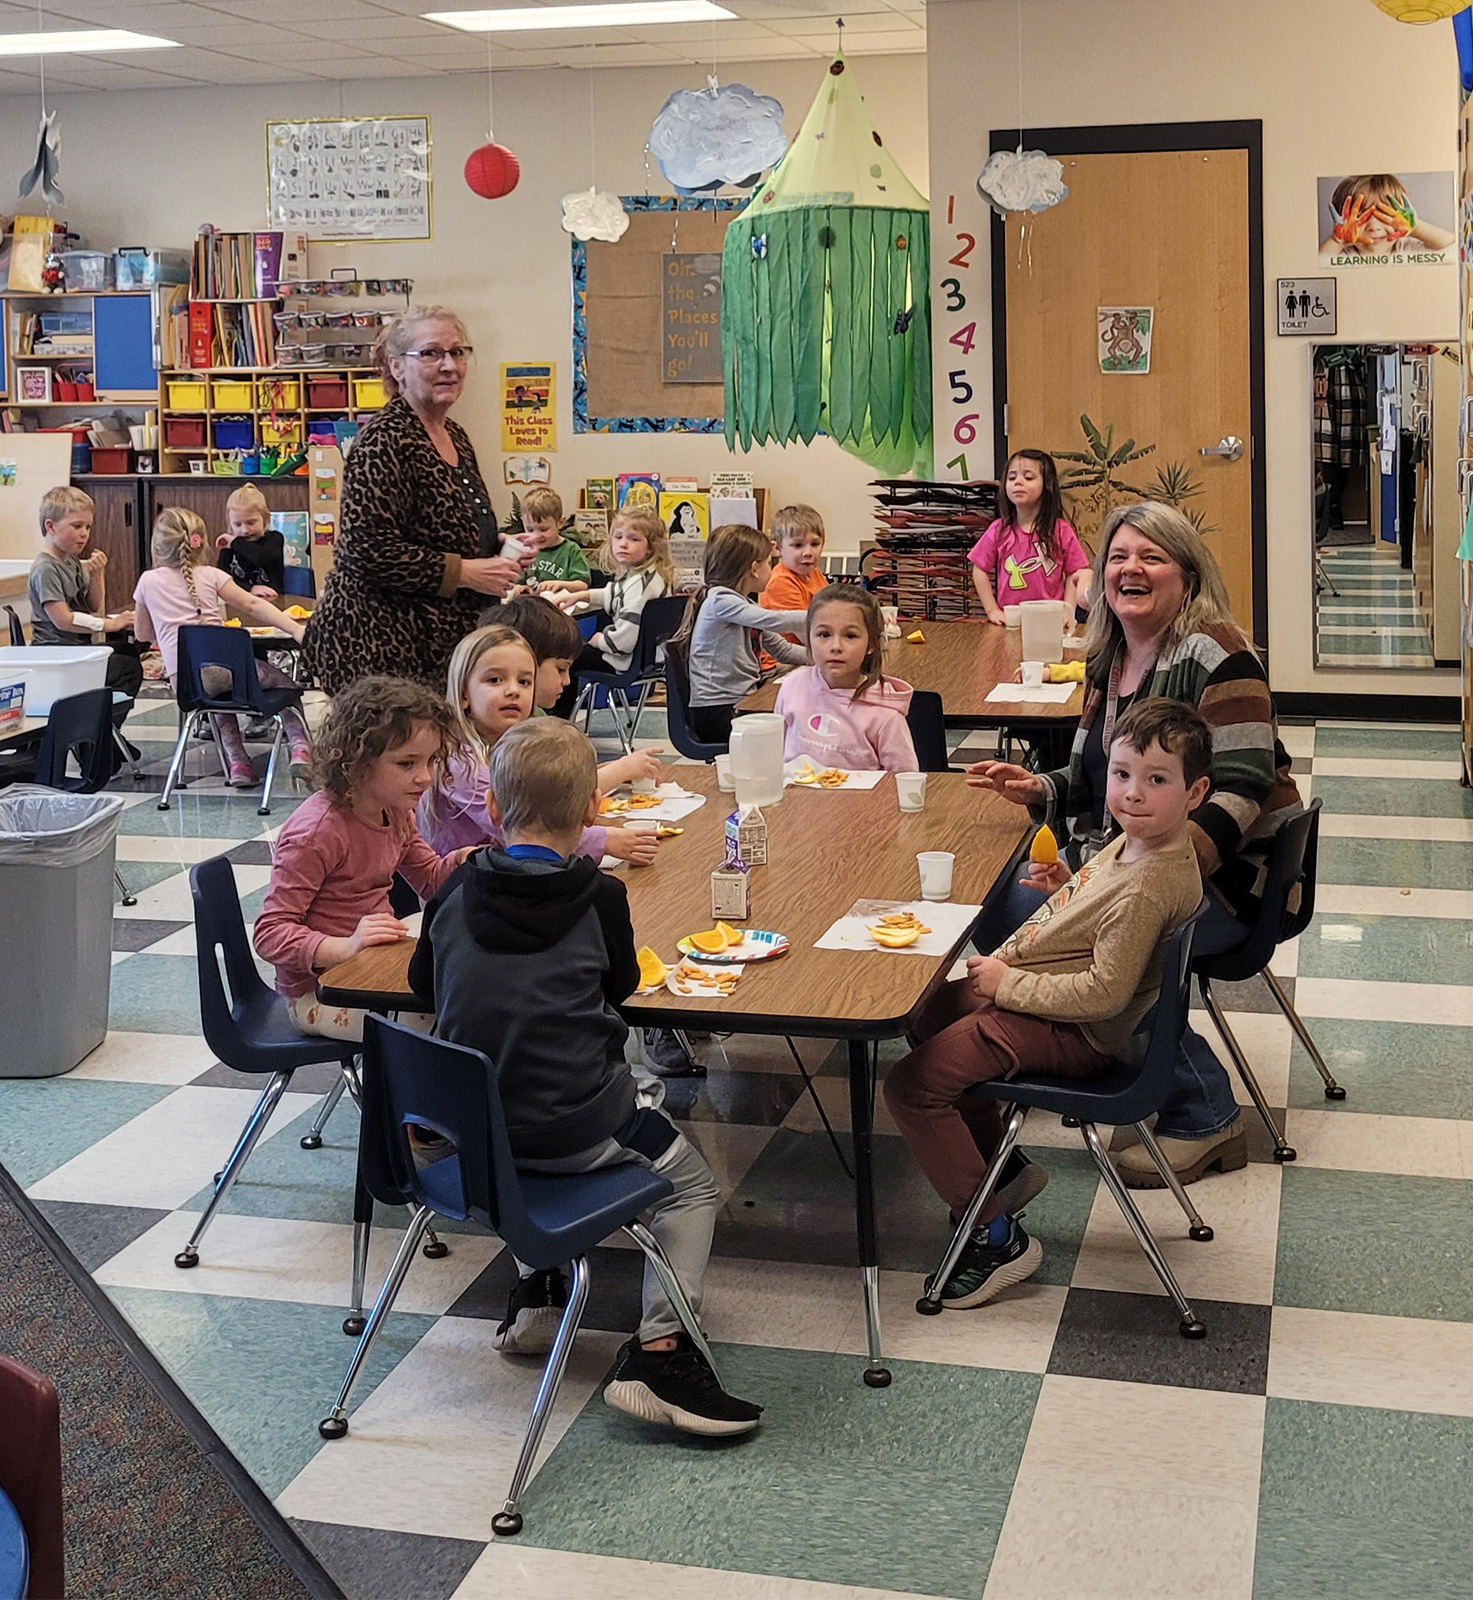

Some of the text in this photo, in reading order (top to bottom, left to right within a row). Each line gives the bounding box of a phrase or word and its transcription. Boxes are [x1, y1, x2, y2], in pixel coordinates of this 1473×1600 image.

[948, 233, 976, 269] 2
[1330, 253, 1446, 266] LEARNING IS MESSY
[667, 283, 694, 300] the
[1280, 281, 1296, 289] 523
[940, 278, 966, 312] 3
[667, 307, 719, 325] Places
[1281, 321, 1308, 329] TOILET
[667, 330, 709, 348] You'll
[948, 321, 977, 355] 4
[667, 356, 693, 378] go!
[948, 370, 973, 404] 5
[504, 415, 553, 426] This Class
[953, 413, 980, 445] 6
[509, 426, 549, 436] Loves to
[515, 436, 542, 446] Read!
[946, 453, 969, 481] 7
[538, 559, 565, 579] STAR
